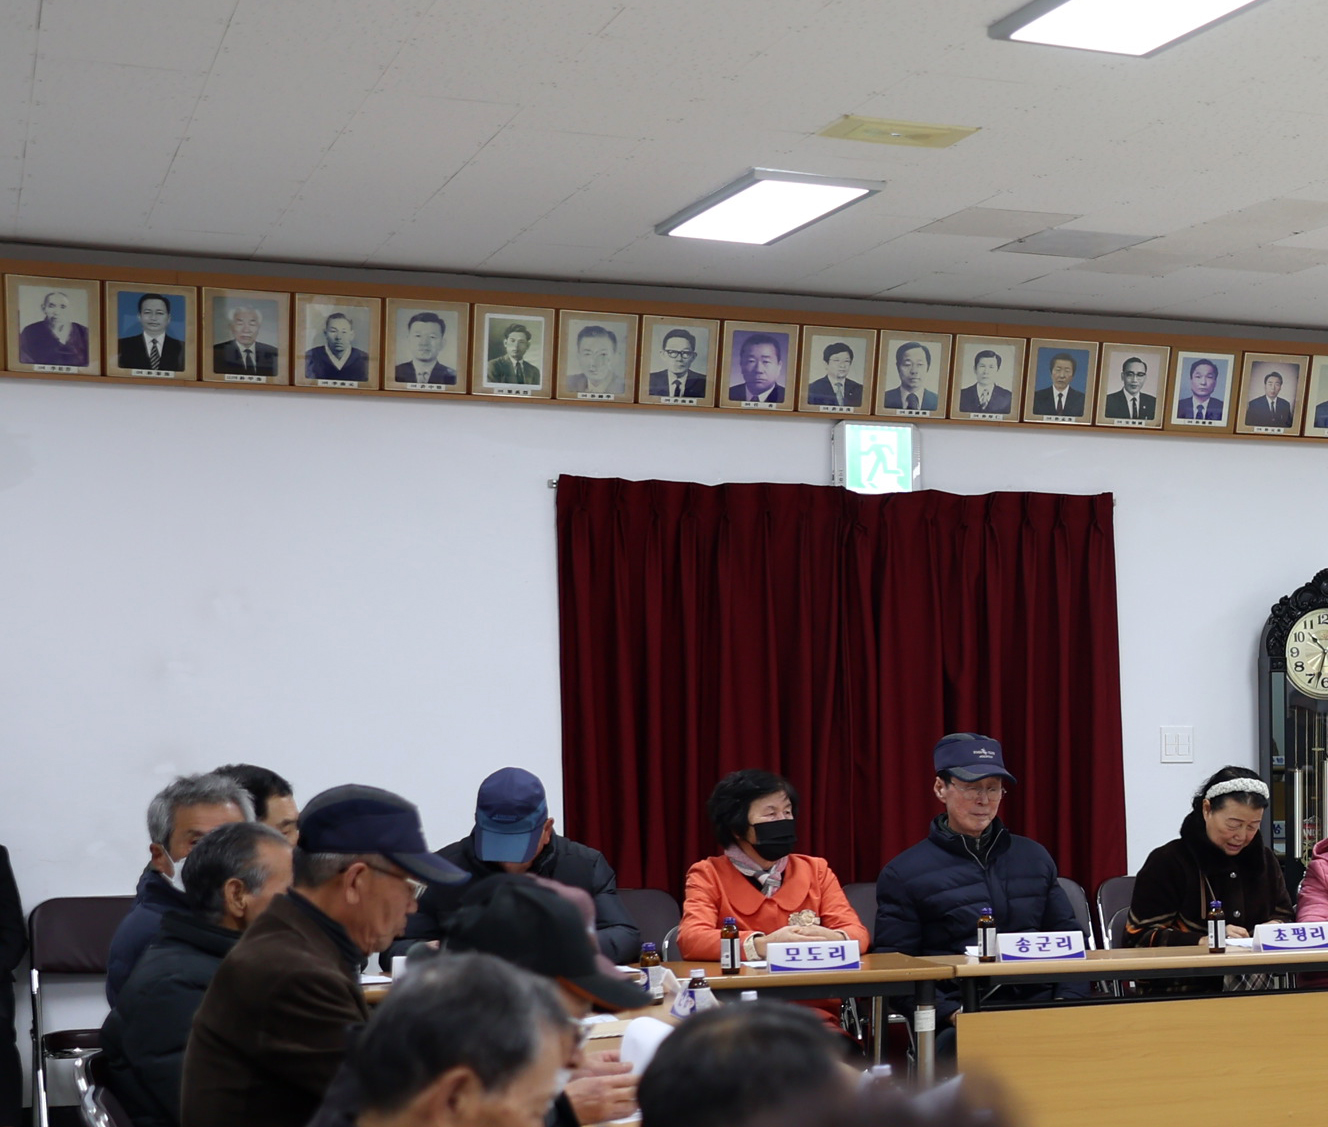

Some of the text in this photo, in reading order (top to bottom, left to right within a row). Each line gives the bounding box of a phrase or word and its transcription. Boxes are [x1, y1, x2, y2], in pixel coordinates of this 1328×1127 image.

[1303, 620, 1314, 629] 11
[1294, 631, 1304, 642] 10
[1290, 647, 1300, 658] 9
[1294, 661, 1304, 672] 8
[1306, 673, 1316, 684] 7
[1275, 927, 1326, 942] 초평리
[1015, 936, 1072, 952] 송군리
[784, 945, 846, 962] 모도리
